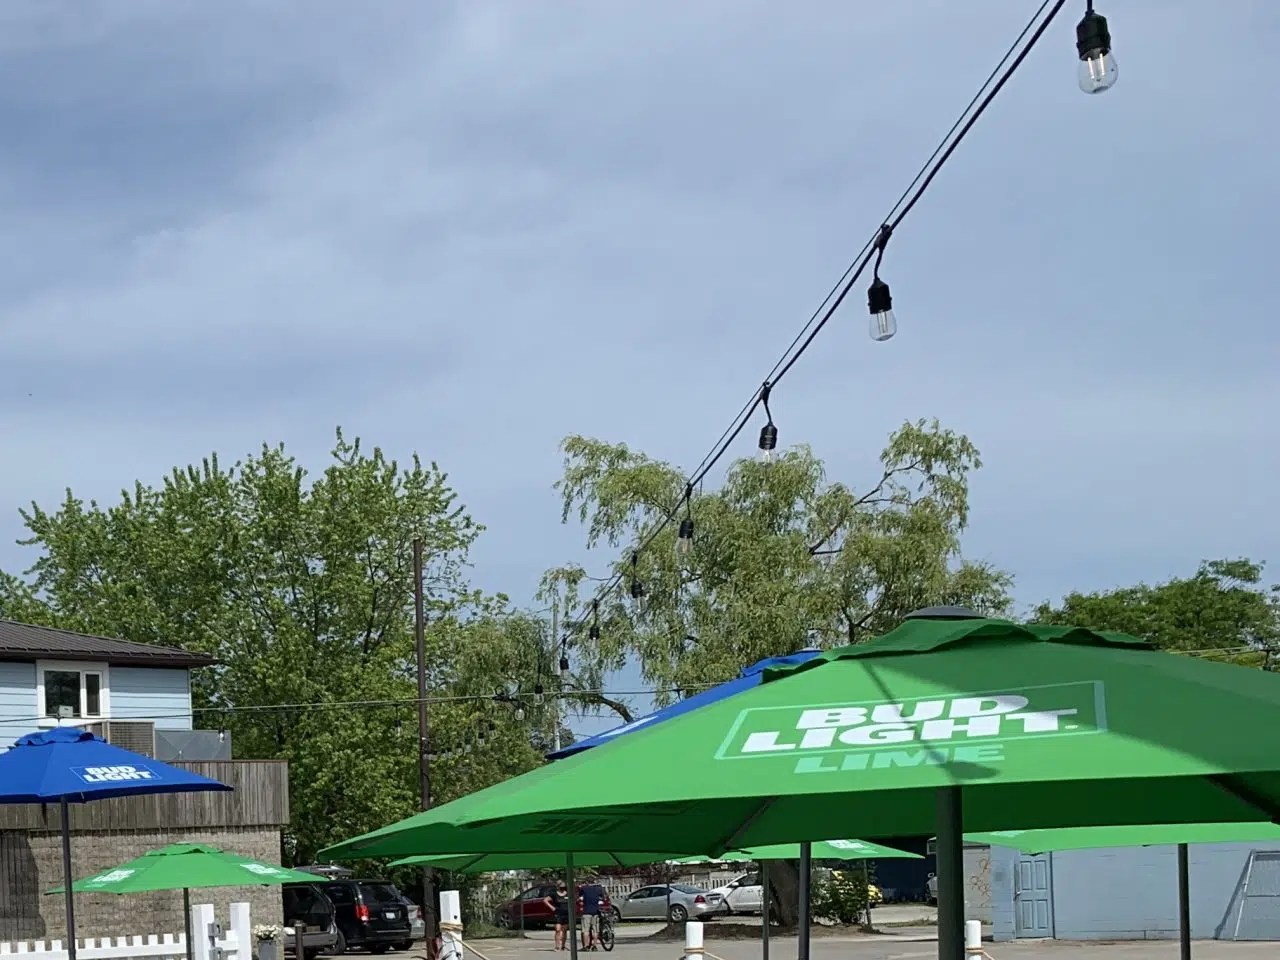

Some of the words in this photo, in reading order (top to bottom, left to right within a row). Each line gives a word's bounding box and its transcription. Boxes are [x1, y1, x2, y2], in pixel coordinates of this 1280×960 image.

[795, 695, 1029, 730] BUD
[740, 708, 1079, 753] LIGHT
[84, 766, 137, 775] BUD
[793, 743, 1006, 774] LIME
[82, 771, 153, 782] LIGHT
